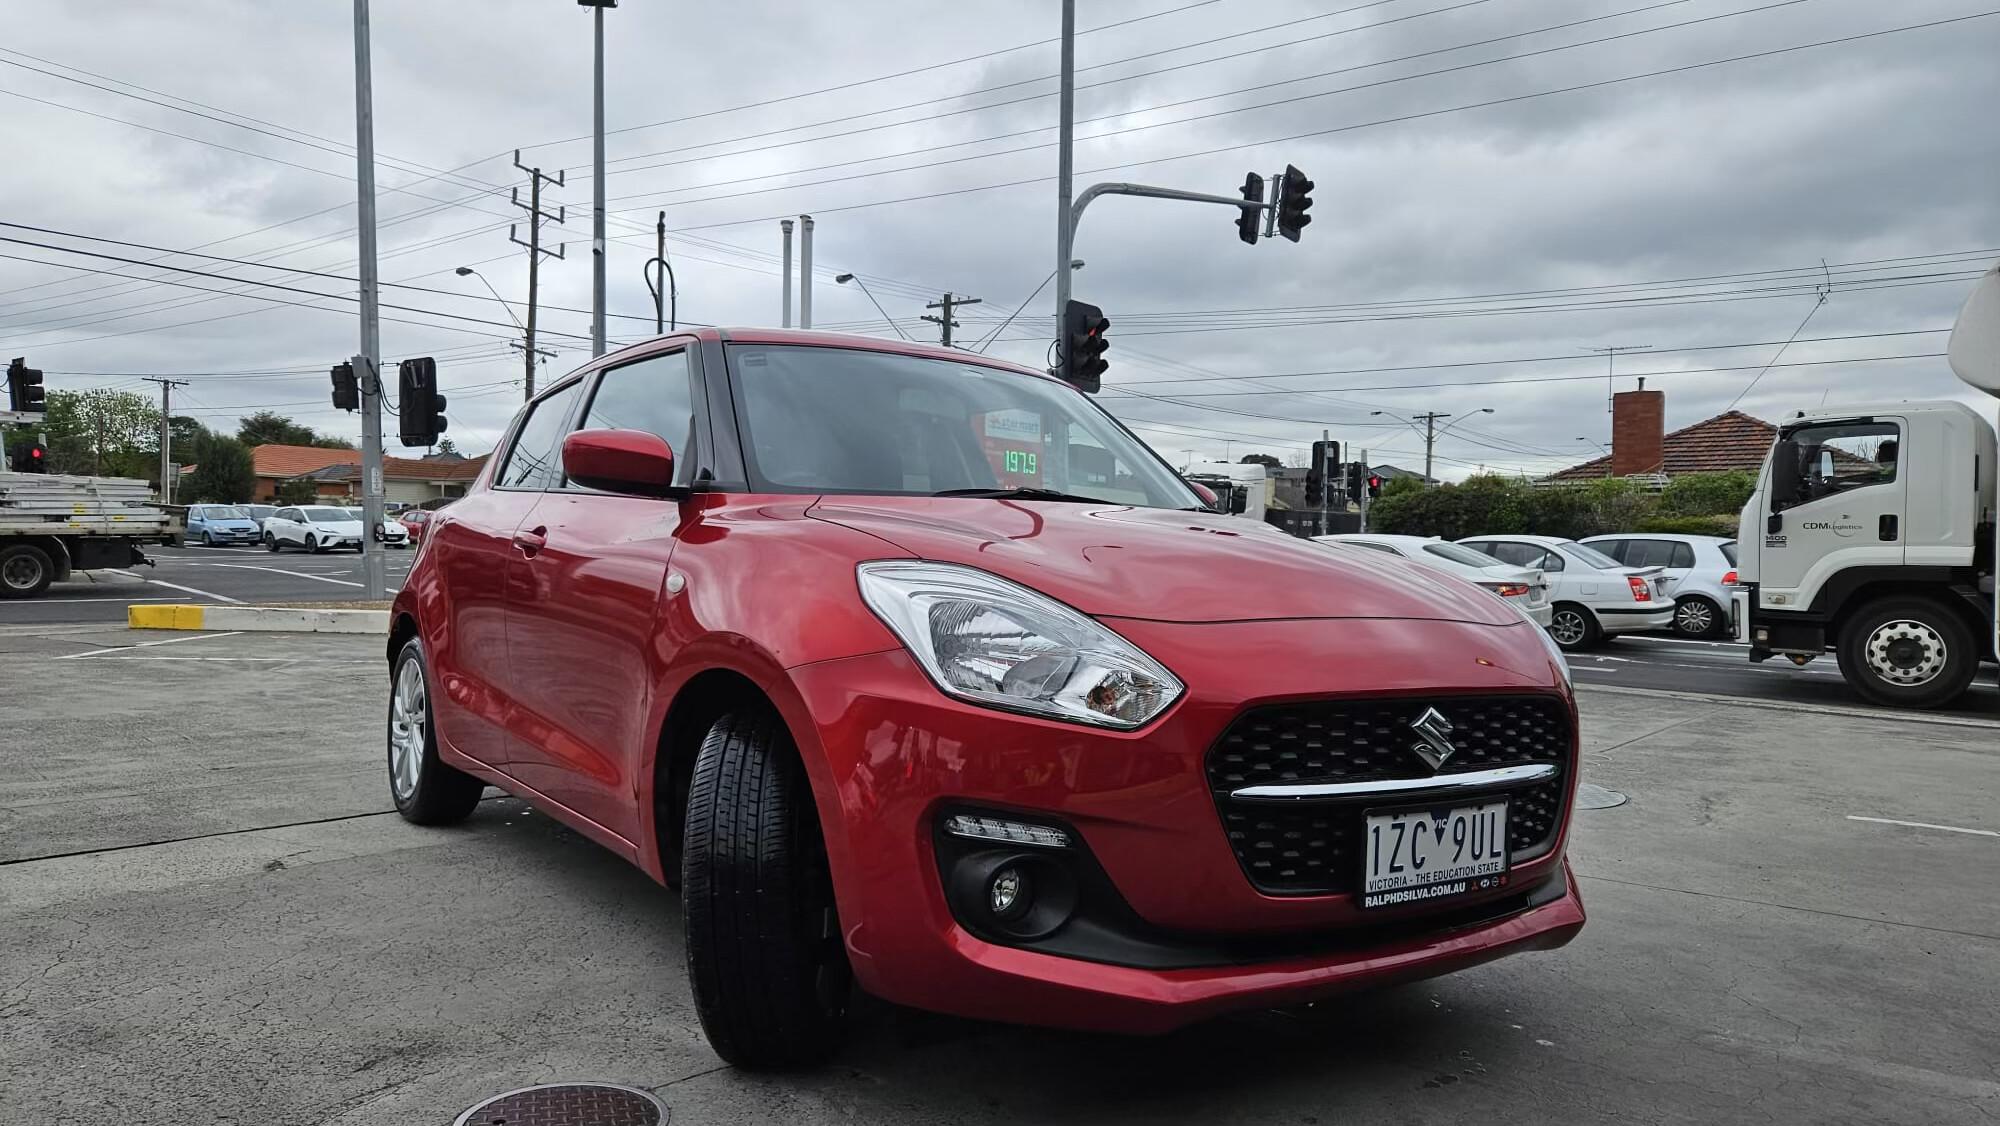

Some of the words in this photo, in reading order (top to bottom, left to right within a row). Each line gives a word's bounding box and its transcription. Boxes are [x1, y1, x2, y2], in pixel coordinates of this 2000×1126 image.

[1434, 818, 1448, 829] VIC
[1369, 876, 1408, 891] VICTORIA
[1416, 872, 1431, 883] THE
[1433, 865, 1475, 881] EDUCATION
[1477, 862, 1499, 872] STATE
[1365, 882, 1466, 907] RALPHDSILVA.COM.AU
